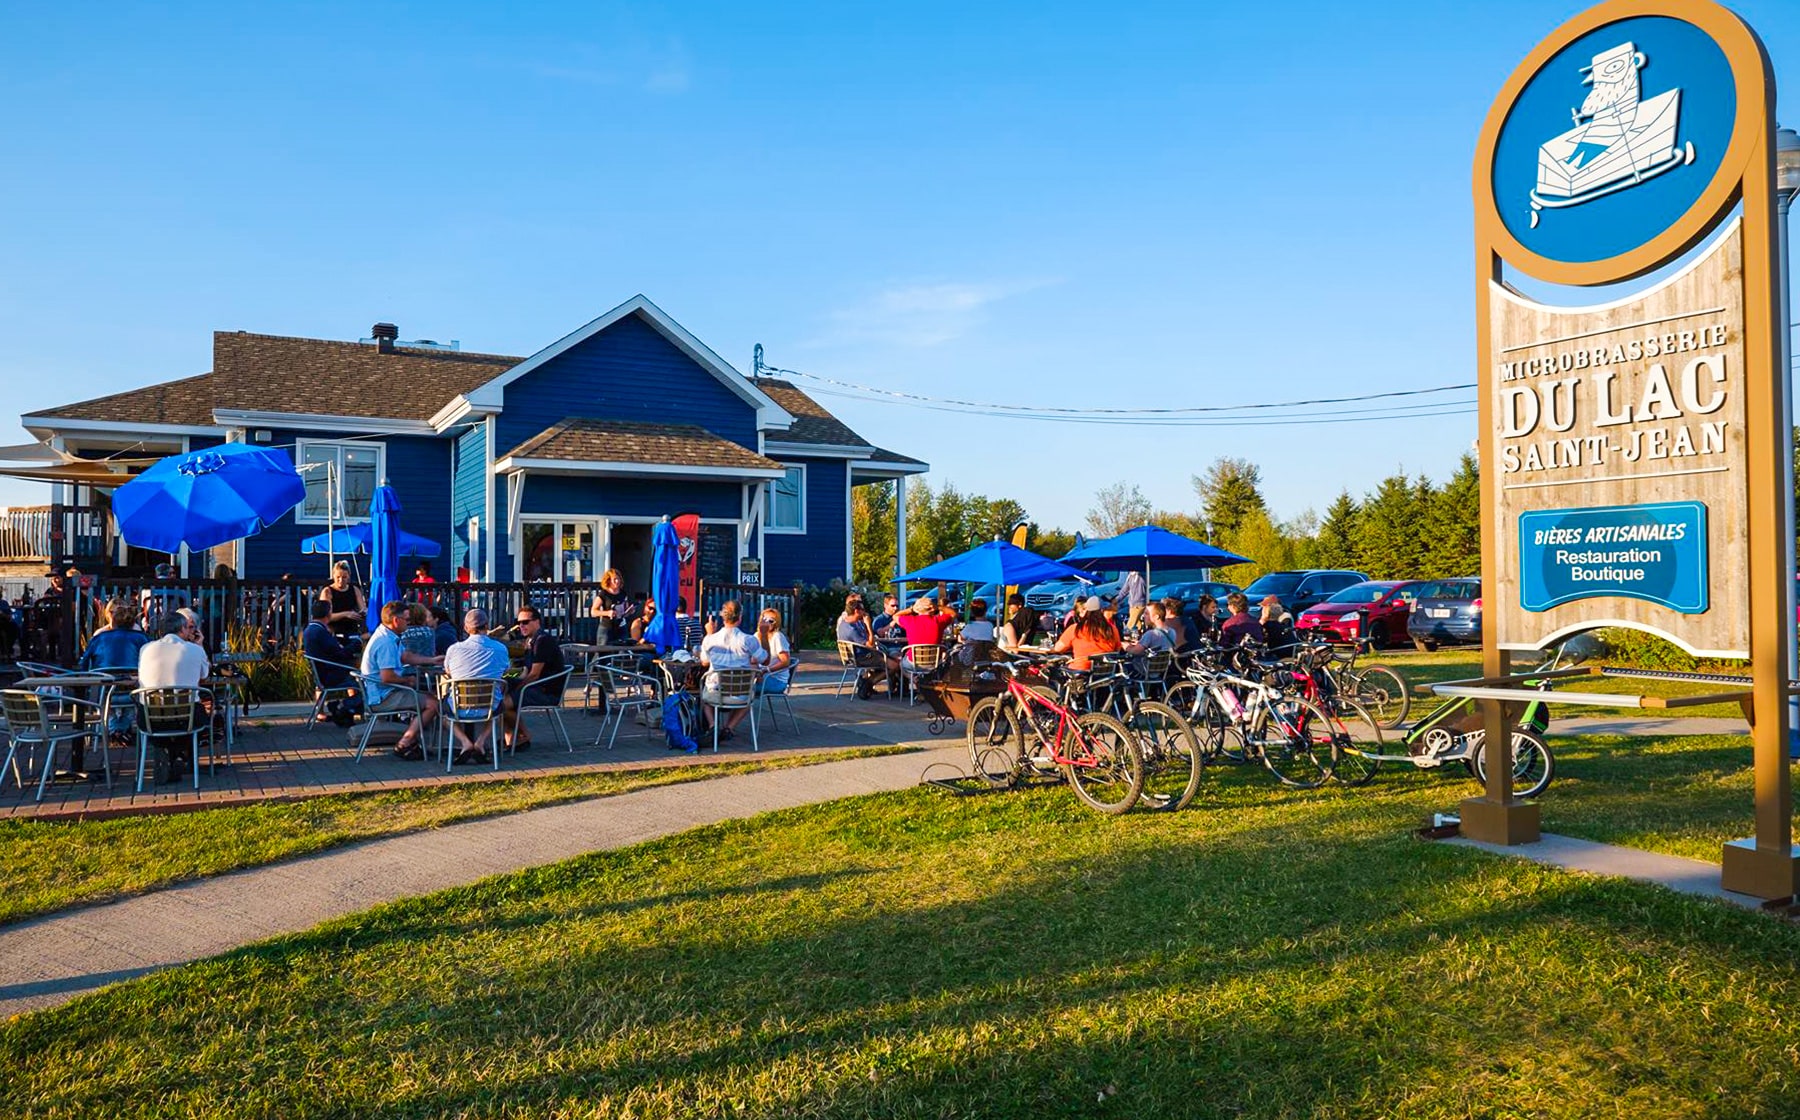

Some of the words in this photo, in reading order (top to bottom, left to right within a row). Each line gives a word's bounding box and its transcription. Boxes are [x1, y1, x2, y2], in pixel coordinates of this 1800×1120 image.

[1500, 325, 1727, 381] MICROBRASSERIE
[1500, 377, 1580, 439] DU
[1593, 353, 1727, 428] LAC
[1502, 421, 1728, 473] SAINT-JEAN
[1534, 526, 1582, 545] BIÈRES
[1585, 523, 1687, 544] ARTISANALES
[1556, 548, 1661, 564] Restauration
[741, 575, 760, 583] PRIX
[1571, 566, 1645, 584] Boutique
